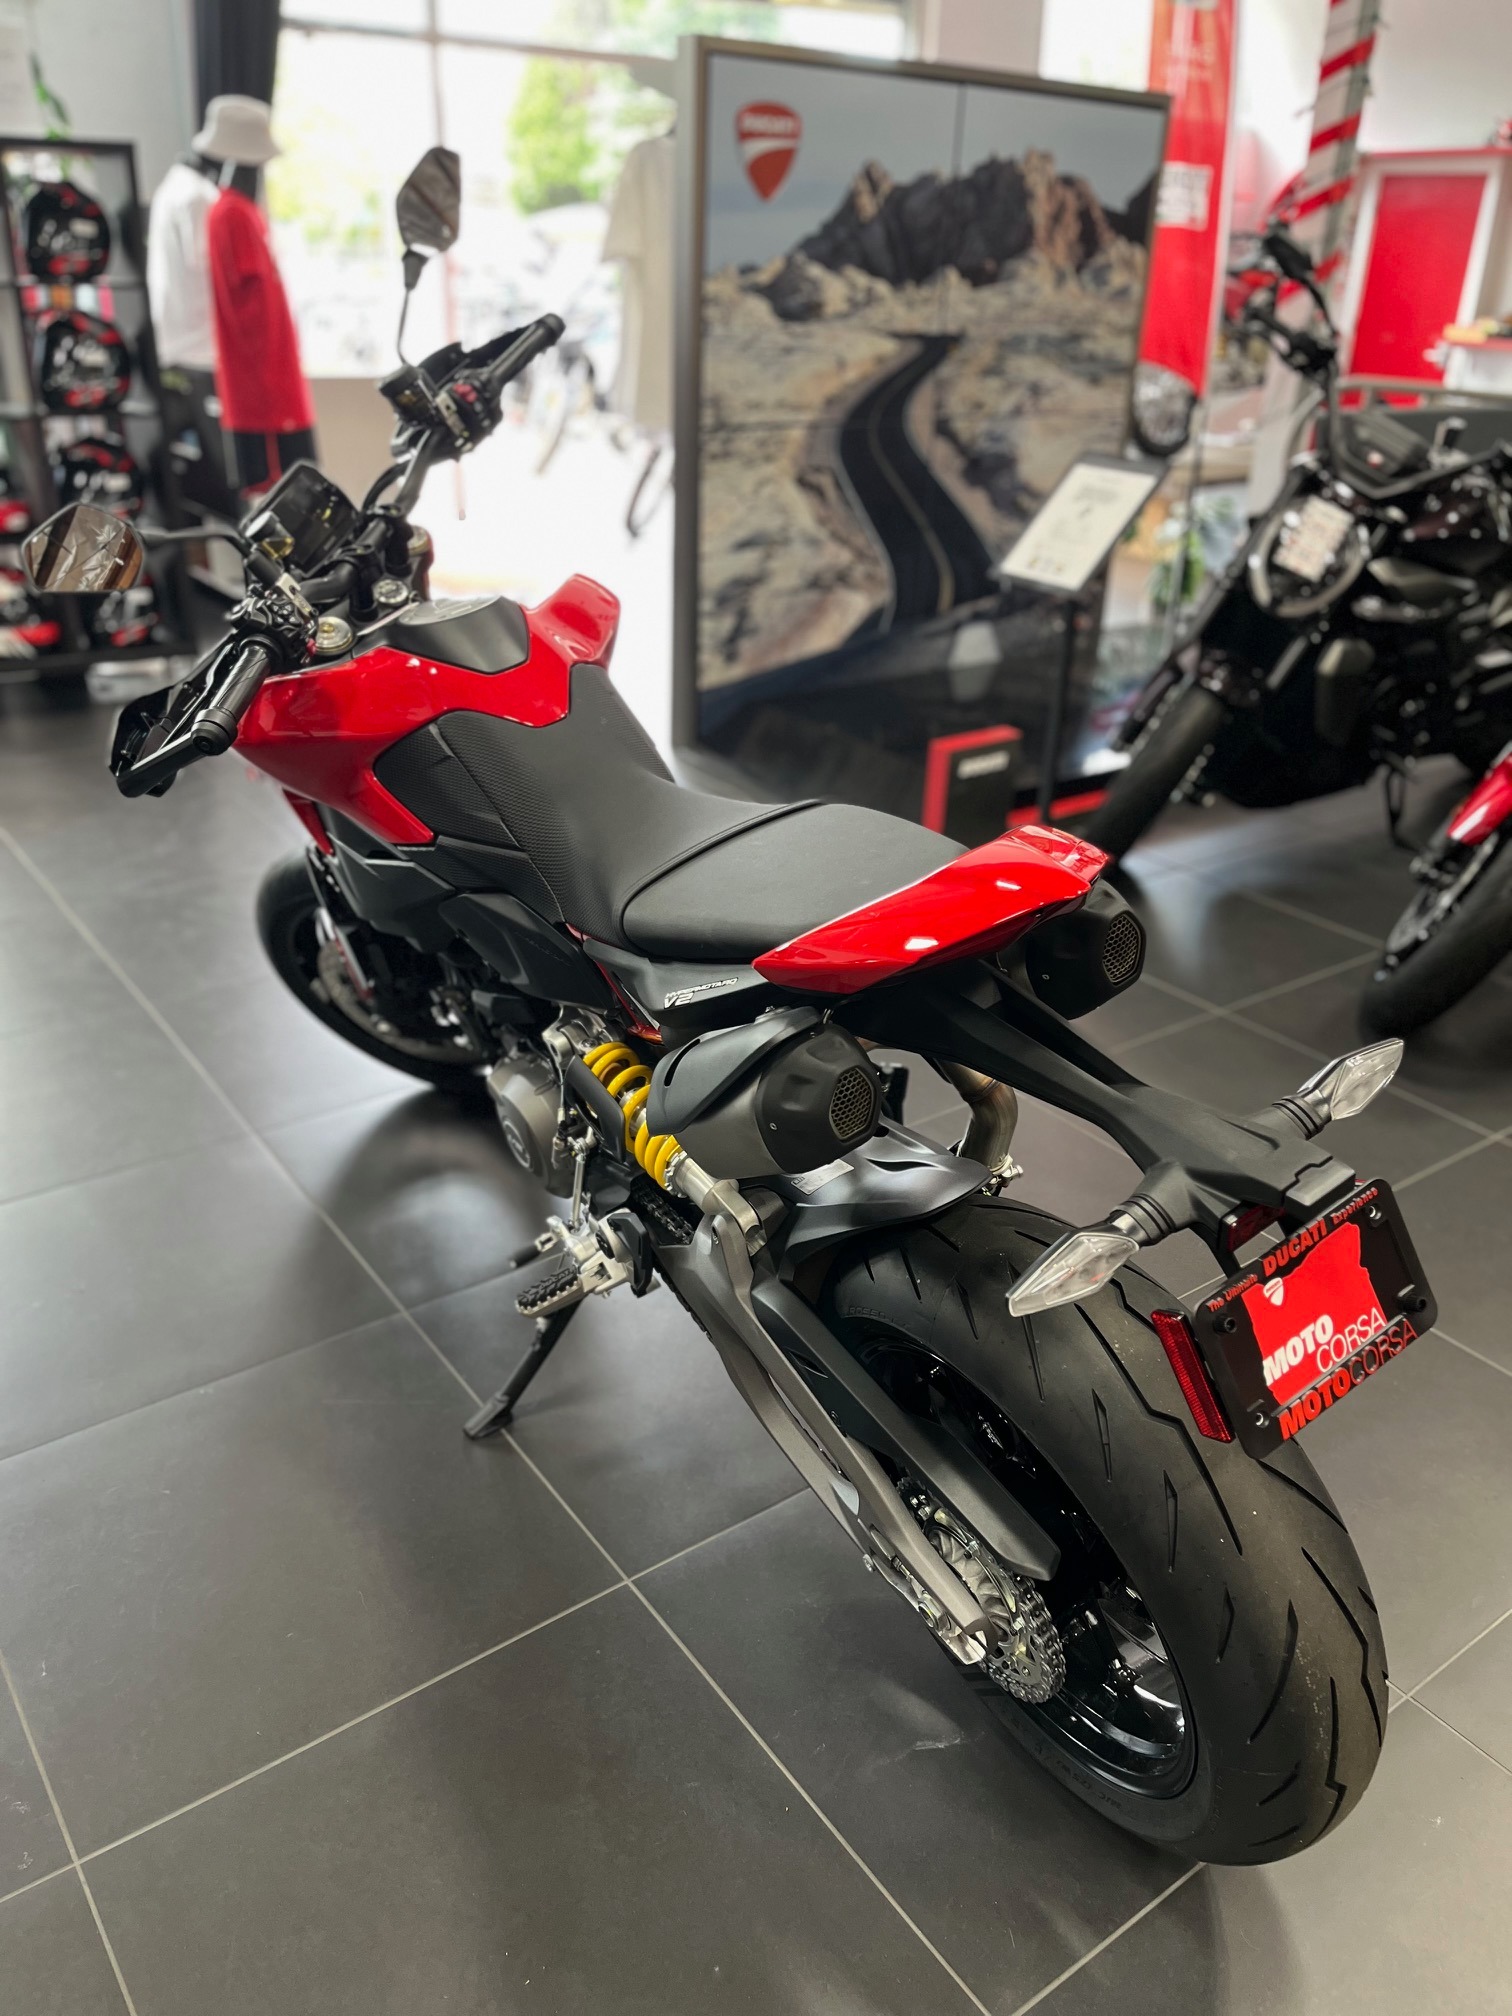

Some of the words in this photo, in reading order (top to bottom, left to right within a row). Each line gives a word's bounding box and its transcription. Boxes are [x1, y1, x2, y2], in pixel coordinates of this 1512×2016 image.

[664, 992, 694, 1009] V2
[1206, 1297, 1225, 1312] The
[1223, 1274, 1259, 1302] Ultimate
[1262, 1218, 1328, 1277] DUCATI
[1331, 1187, 1379, 1225] Experience
[1263, 1314, 1334, 1387] MOTO
[1316, 1307, 1386, 1373] CORSA
